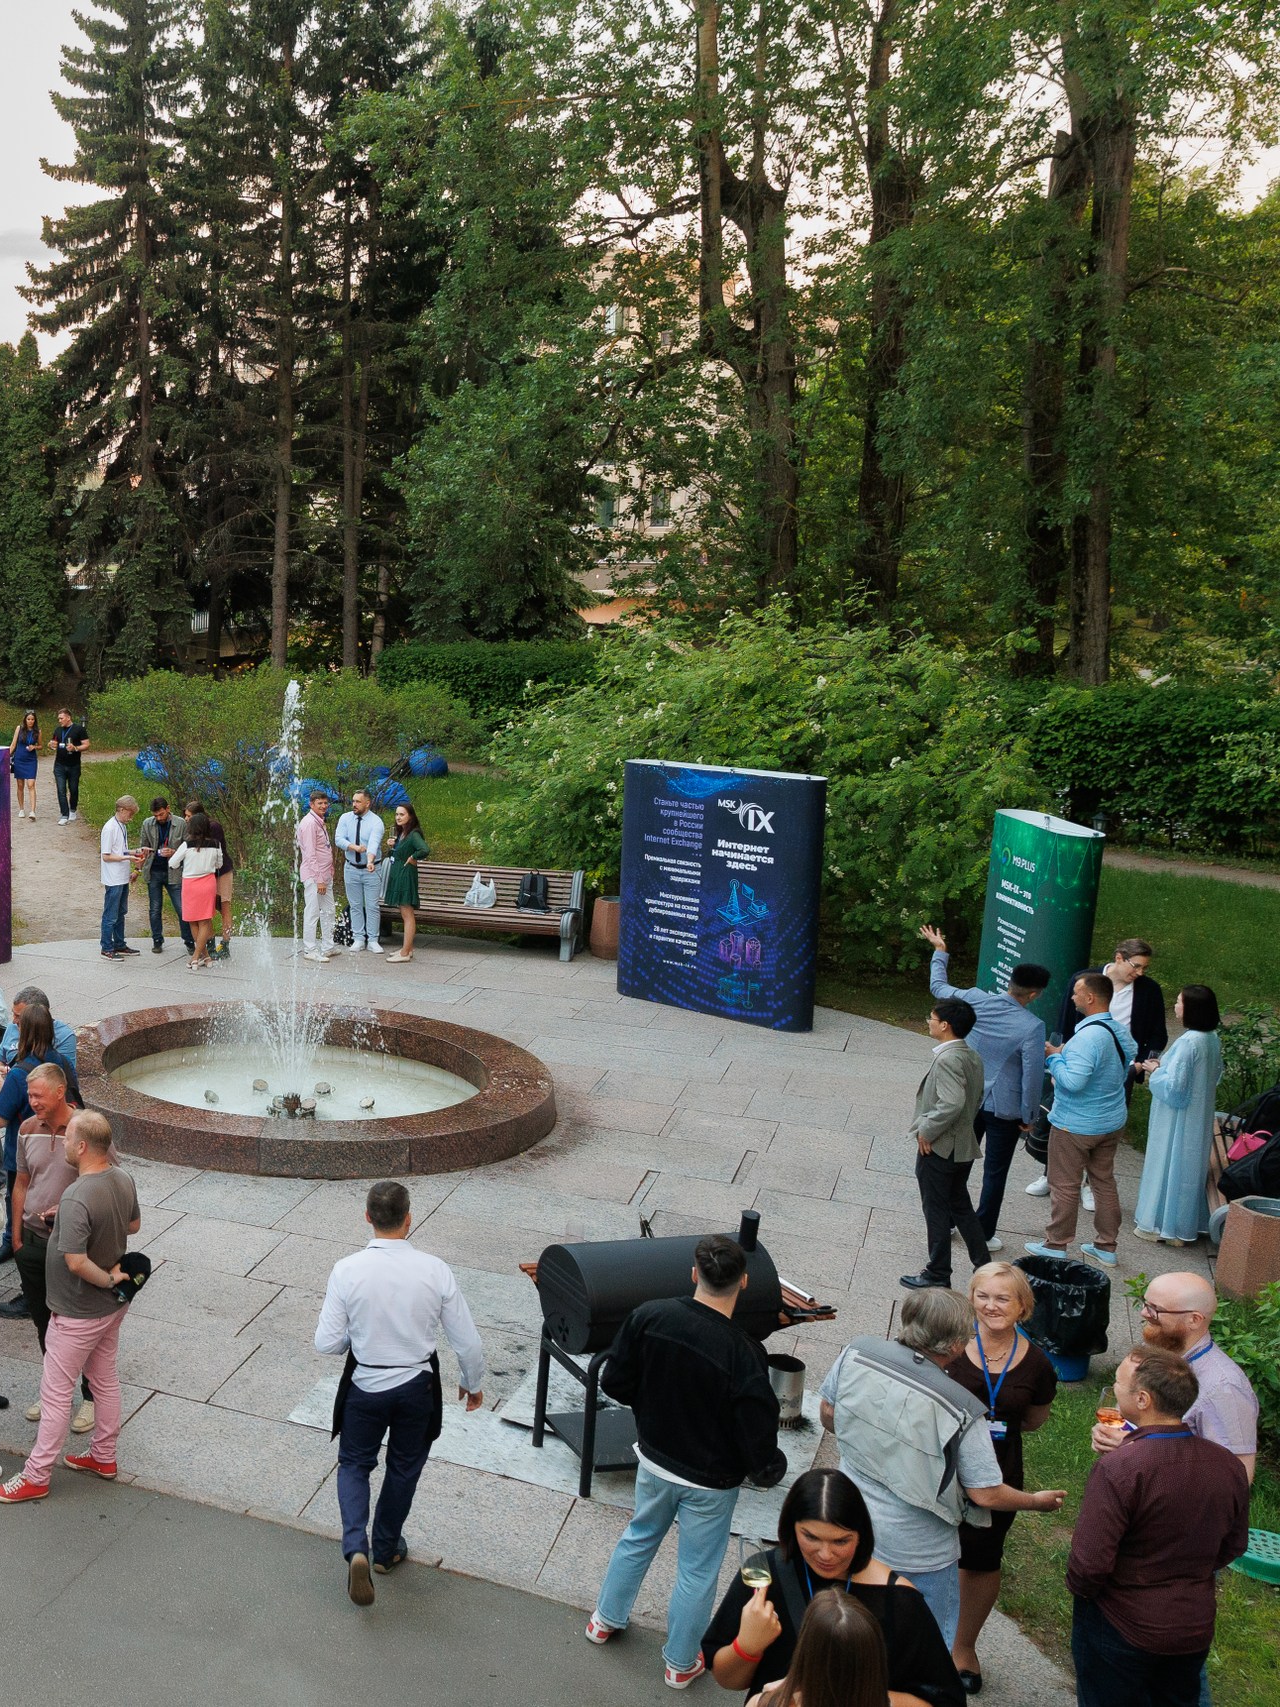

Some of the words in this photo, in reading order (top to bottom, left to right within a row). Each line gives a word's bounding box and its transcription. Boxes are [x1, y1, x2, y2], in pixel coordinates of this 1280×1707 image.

[654, 797, 679, 807] Станьте
[680, 800, 704, 810] частью
[660, 808, 704, 820] крупнейшего
[718, 799, 736, 808] MSK
[748, 809, 775, 834] IX
[680, 820, 703, 830] России
[662, 827, 703, 839] сообщества
[644, 834, 670, 844] Internet
[671, 838, 703, 850] Exchange
[717, 839, 769, 854] Интернет
[712, 849, 774, 864] начинается
[726, 860, 758, 872] здесь
